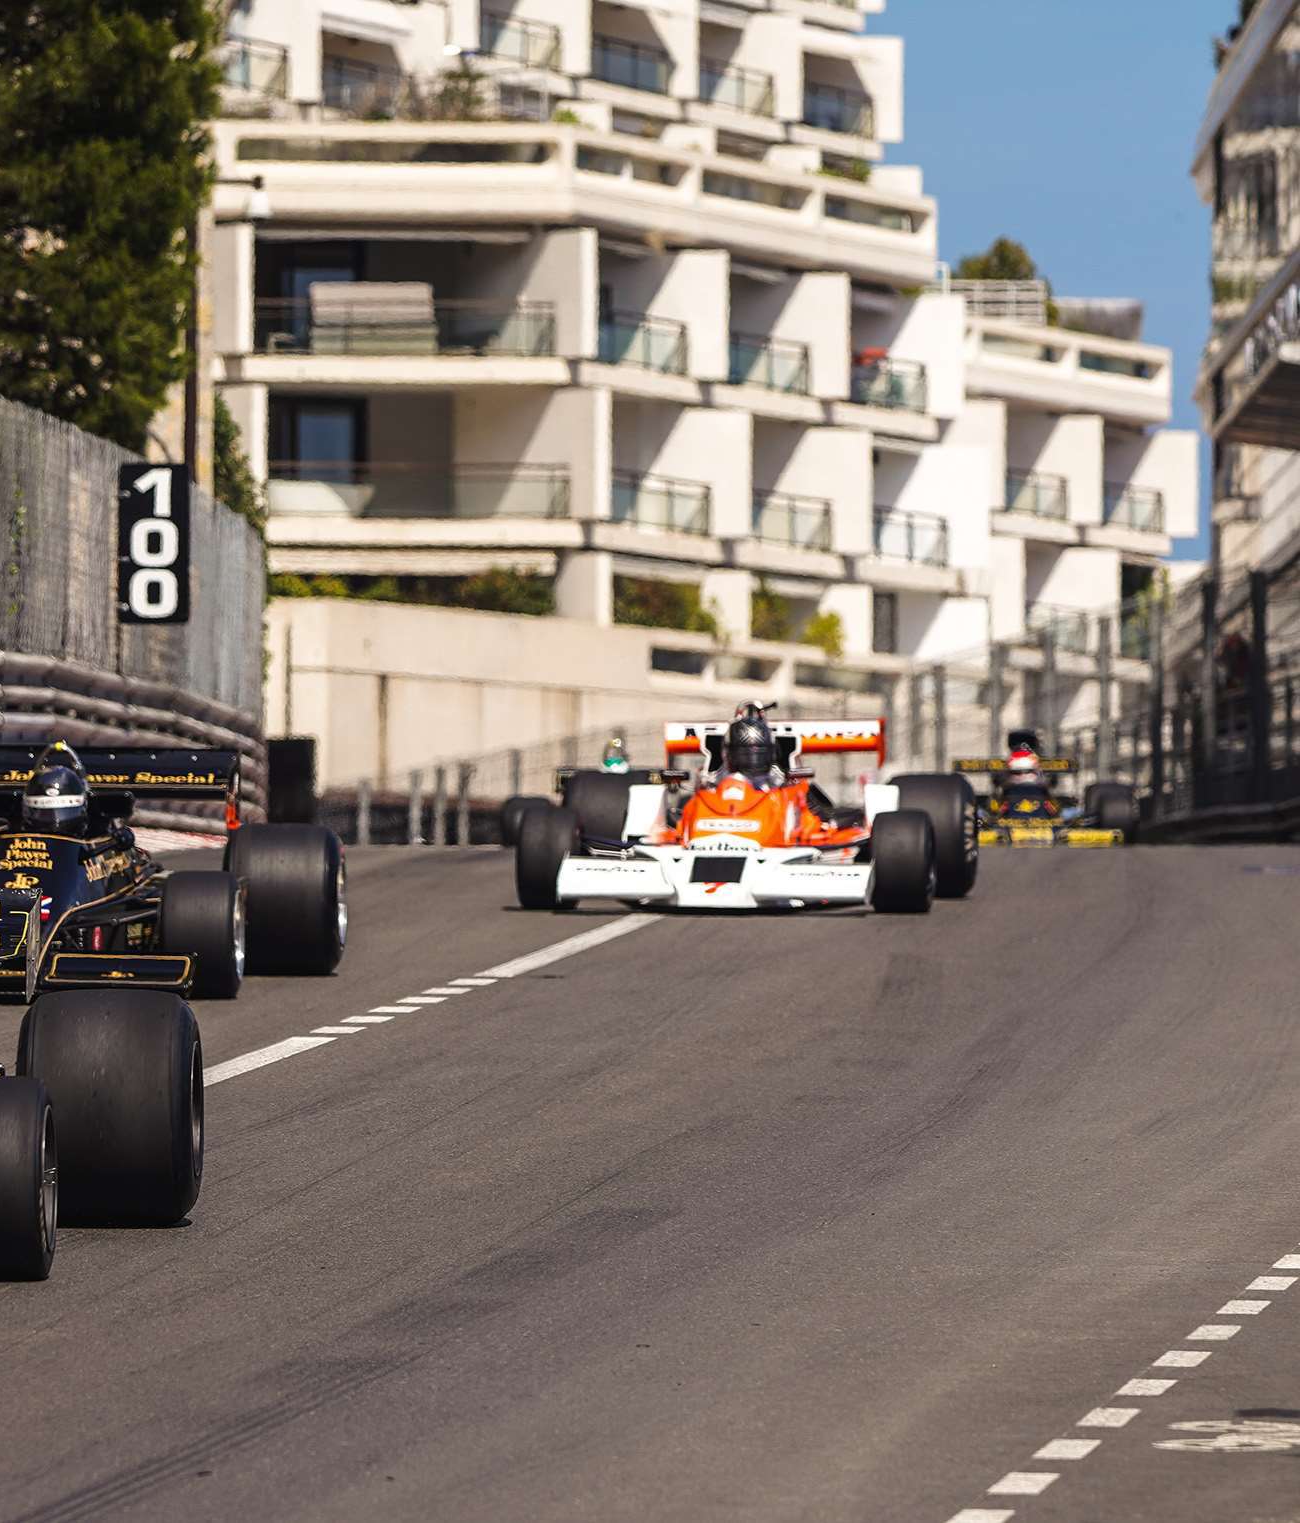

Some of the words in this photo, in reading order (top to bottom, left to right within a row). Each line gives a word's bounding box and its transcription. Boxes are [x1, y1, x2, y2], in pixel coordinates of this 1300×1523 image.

[129, 467, 179, 619] 100
[134, 771, 215, 784] Special
[10, 838, 47, 850] John
[6, 849, 50, 861] Player
